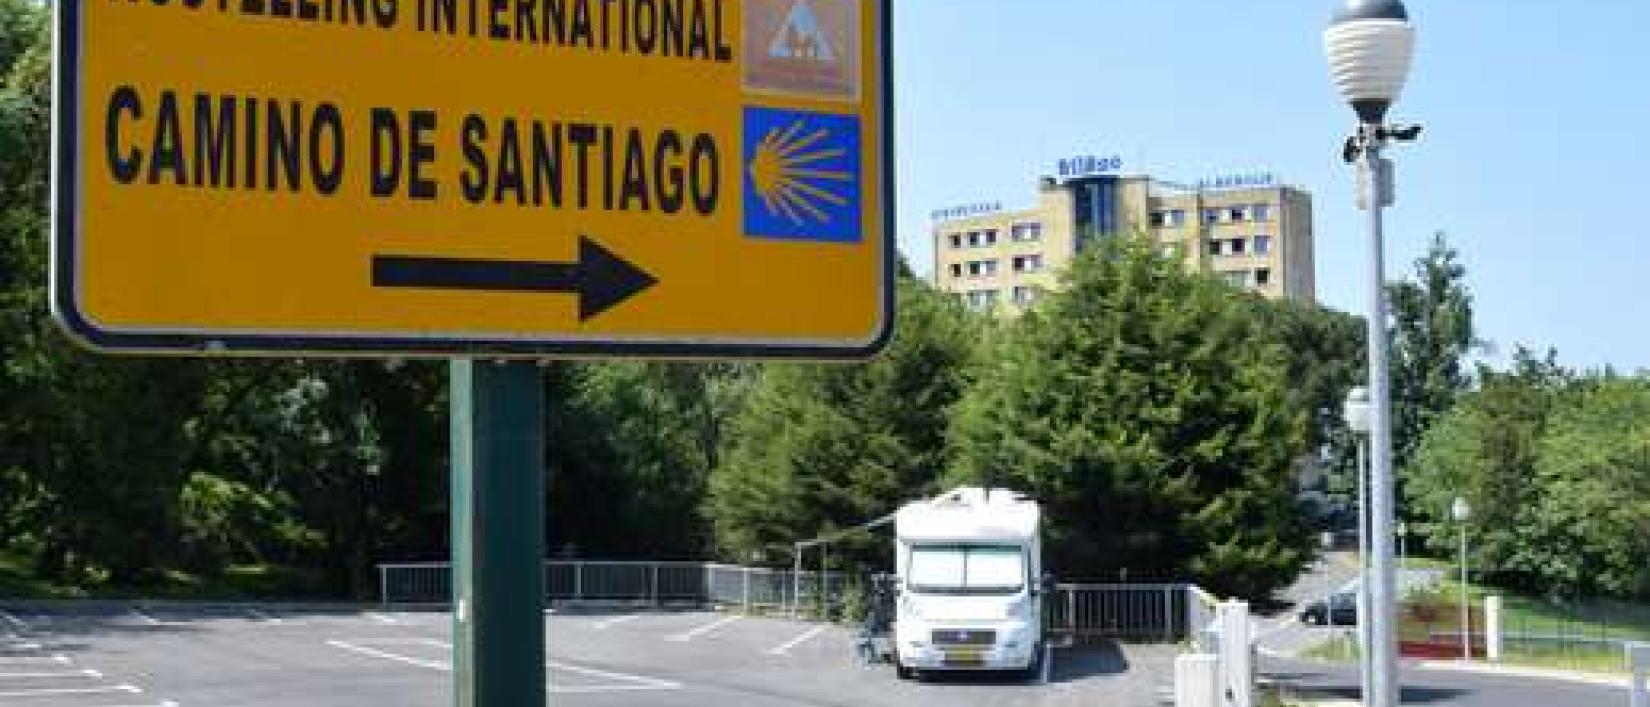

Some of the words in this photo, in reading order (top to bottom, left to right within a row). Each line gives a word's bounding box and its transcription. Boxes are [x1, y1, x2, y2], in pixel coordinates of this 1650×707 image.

[416, 0, 732, 62] INTERNATIONAL
[105, 84, 347, 195] CAMINO
[369, 107, 438, 201] DE
[459, 113, 720, 217] SANTIAGO
